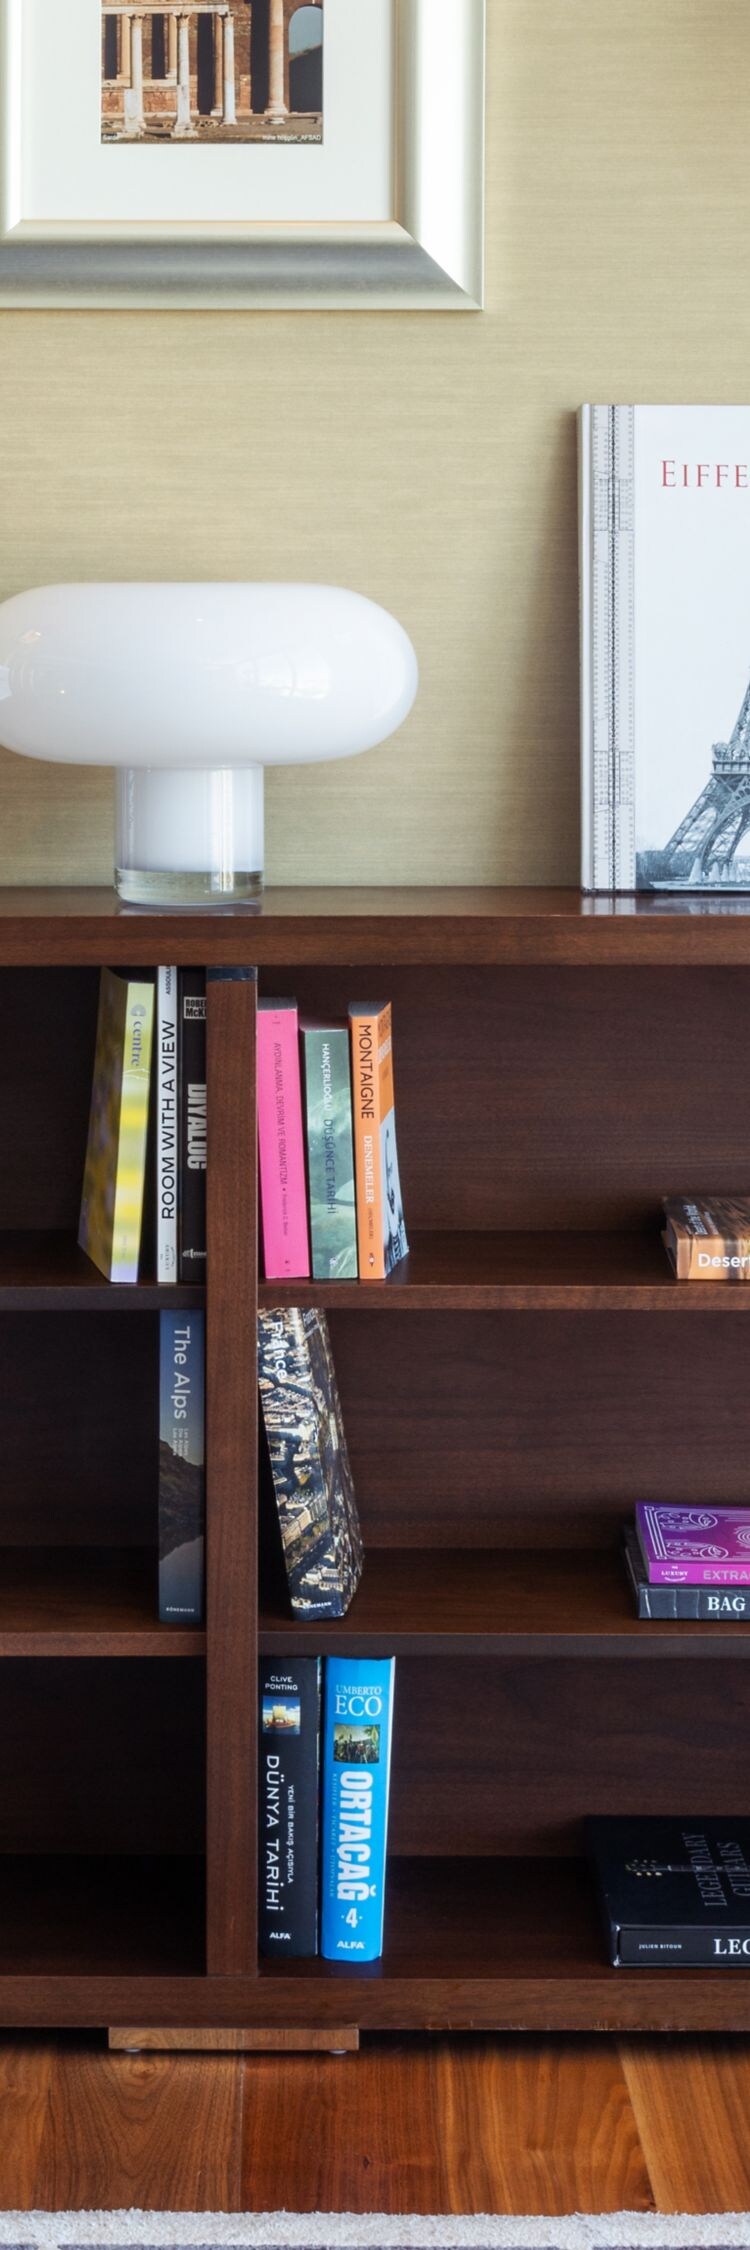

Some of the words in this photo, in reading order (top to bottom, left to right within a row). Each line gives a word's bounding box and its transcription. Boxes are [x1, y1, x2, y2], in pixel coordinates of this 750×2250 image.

[660, 460, 749, 488] EIFFE
[130, 1021, 143, 1067] centre
[161, 1020, 175, 1075] VIEW
[161, 1079, 175, 1092] A
[359, 1025, 374, 1119] MONTAIGNE
[161, 1098, 175, 1151] WITH
[277, 1127, 286, 1137] VE
[322, 1119, 336, 1173] DÜŞÜNCE
[161, 1157, 175, 1219] ROOM
[363, 1135, 375, 1204] DENEMELER
[698, 1253, 750, 1268] Deser
[173, 1325, 191, 1365] The
[270, 1321, 288, 1381] Frnce
[170, 1371, 191, 1420] Alps
[703, 1570, 750, 1580] EXTRA
[707, 1596, 746, 1611] BAG
[265, 1683, 299, 1691] PONTING
[270, 1675, 293, 1683] CLIVE
[335, 1684, 382, 1695] UMBERTO
[335, 1695, 382, 1716] ECO
[266, 1755, 285, 1828] DÜNYA
[337, 1771, 376, 1901] ORTAÇAĞ
[266, 1838, 285, 1911] TARİHİ
[269, 1931, 291, 1939] ALFA
[337, 1940, 365, 1949] ALFA
